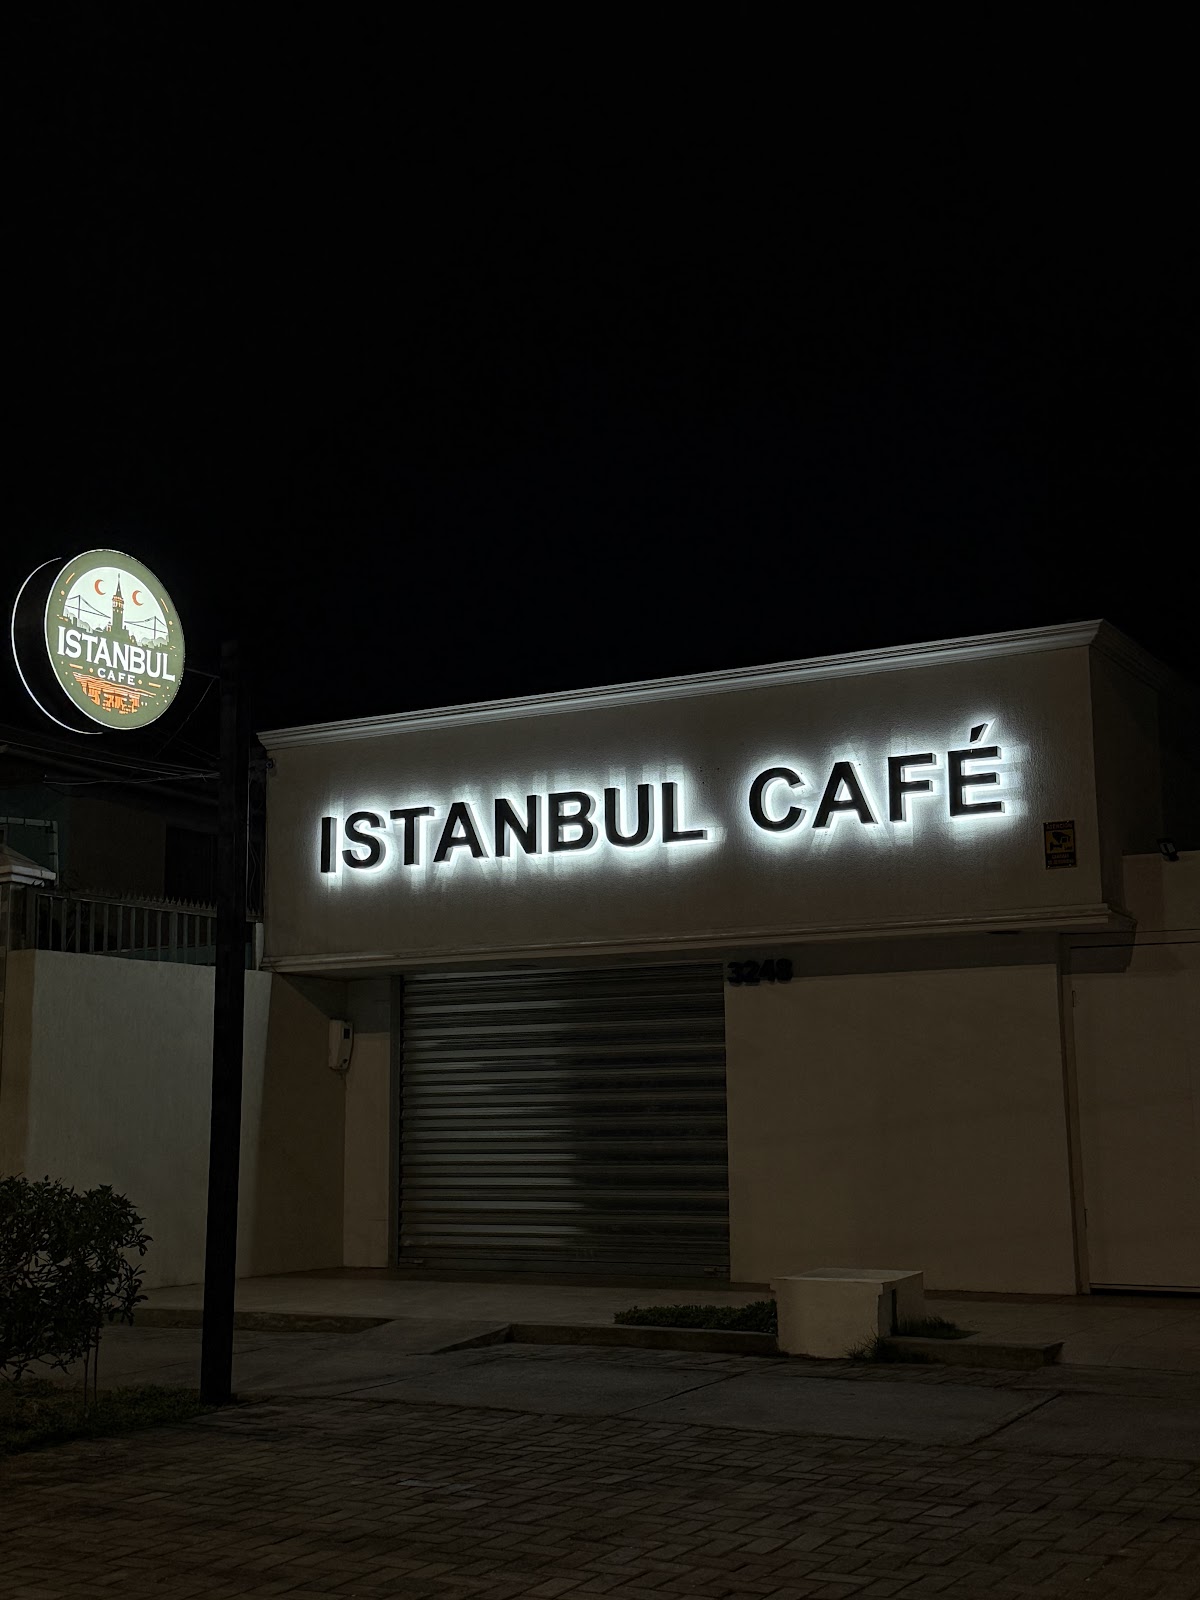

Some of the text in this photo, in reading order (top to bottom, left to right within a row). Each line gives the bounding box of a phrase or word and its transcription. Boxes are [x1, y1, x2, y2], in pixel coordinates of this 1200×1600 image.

[57, 626, 175, 681] ISTANBUL
[320, 723, 1005, 873] ISTANBUL CAFÉ
